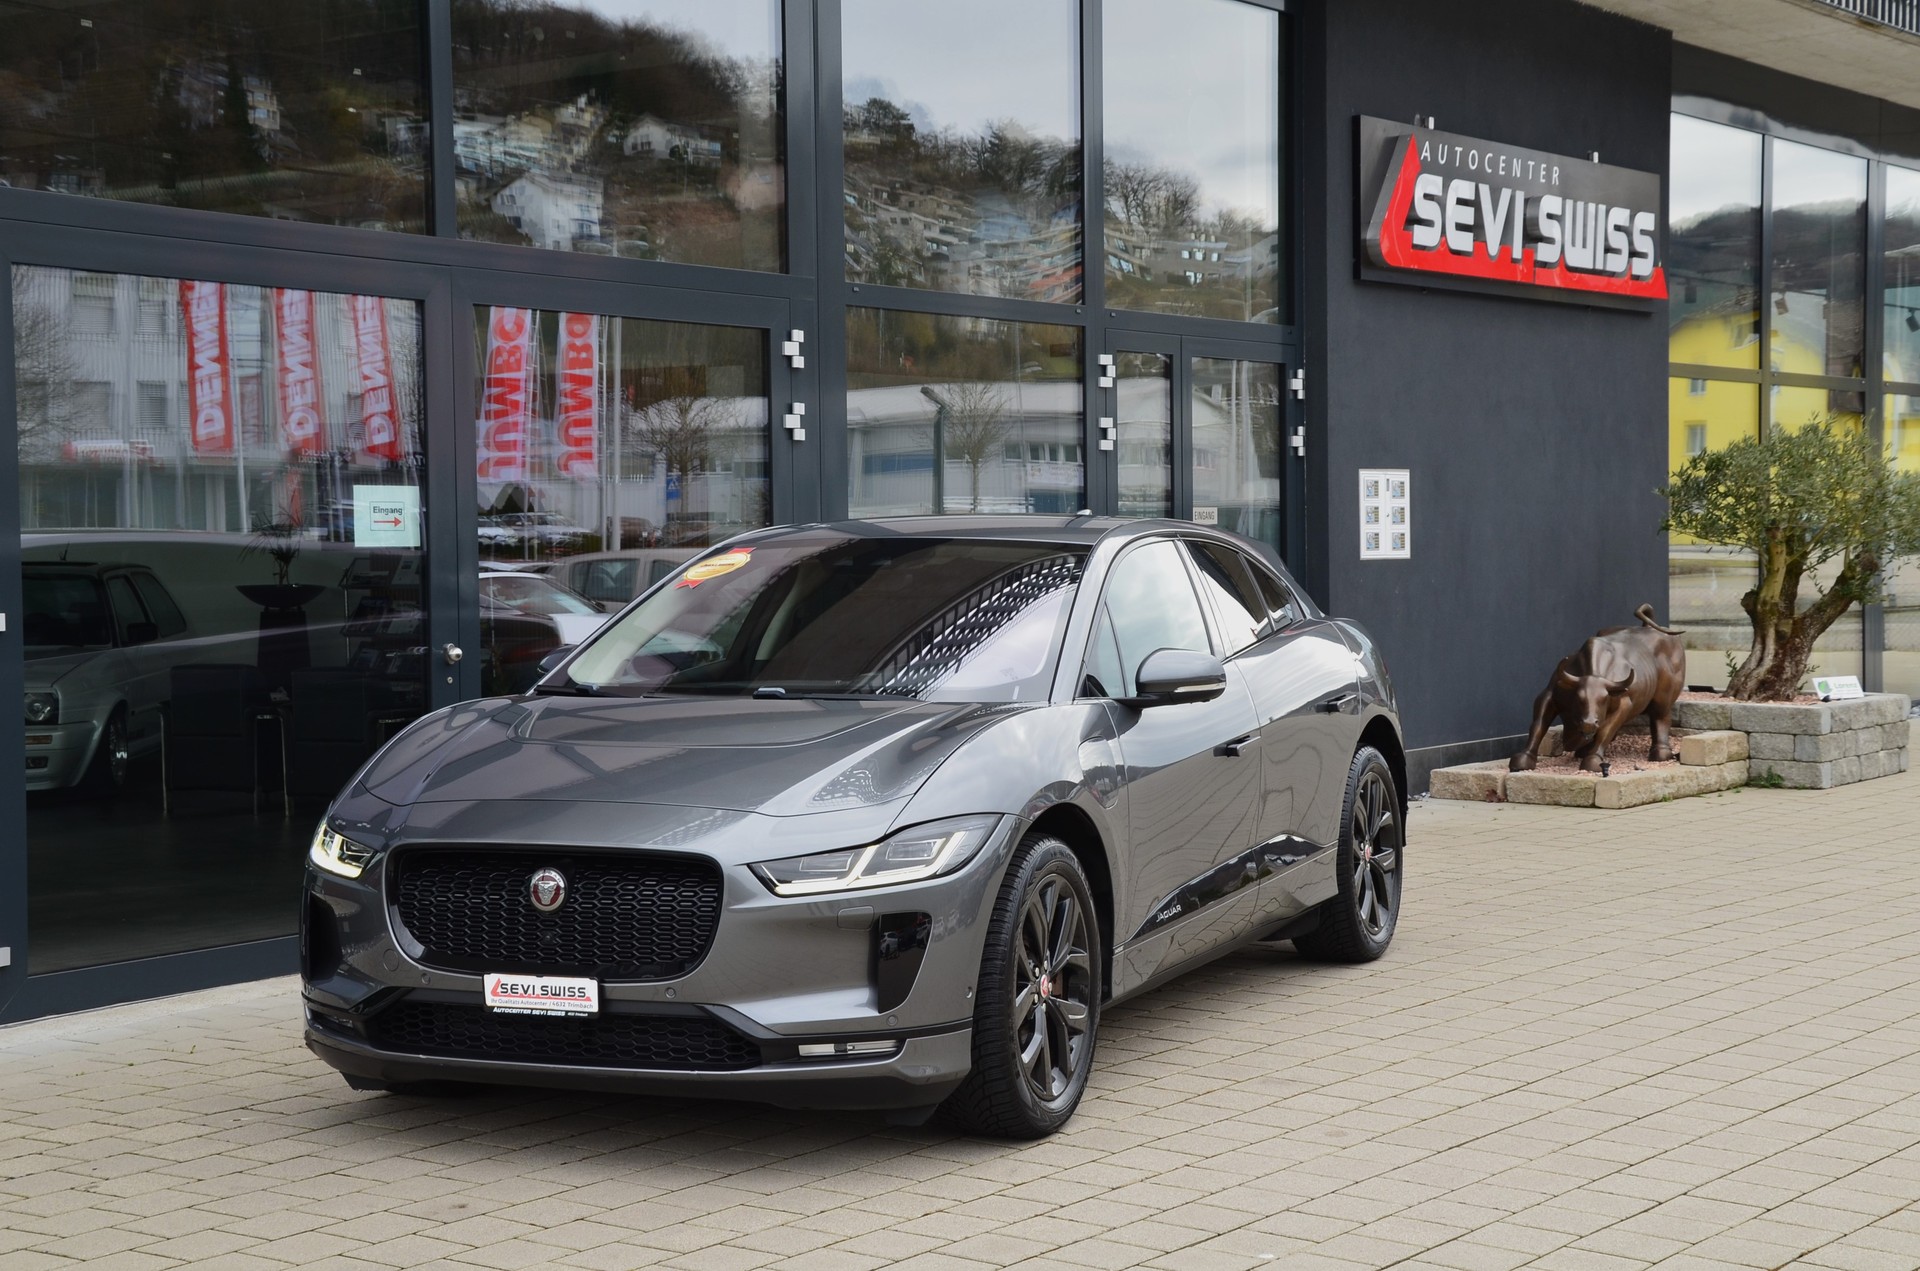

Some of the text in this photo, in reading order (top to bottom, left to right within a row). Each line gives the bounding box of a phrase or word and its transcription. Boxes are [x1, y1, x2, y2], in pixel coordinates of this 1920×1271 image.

[1420, 140, 1560, 186] AUTOCENTER
[1411, 172, 1656, 278] SEVI SWISS
[372, 506, 403, 516] Eingang
[1194, 511, 1215, 520] EINGANG
[1156, 904, 1182, 922] JAGUAR
[500, 983, 587, 998] SEVI SWISS
